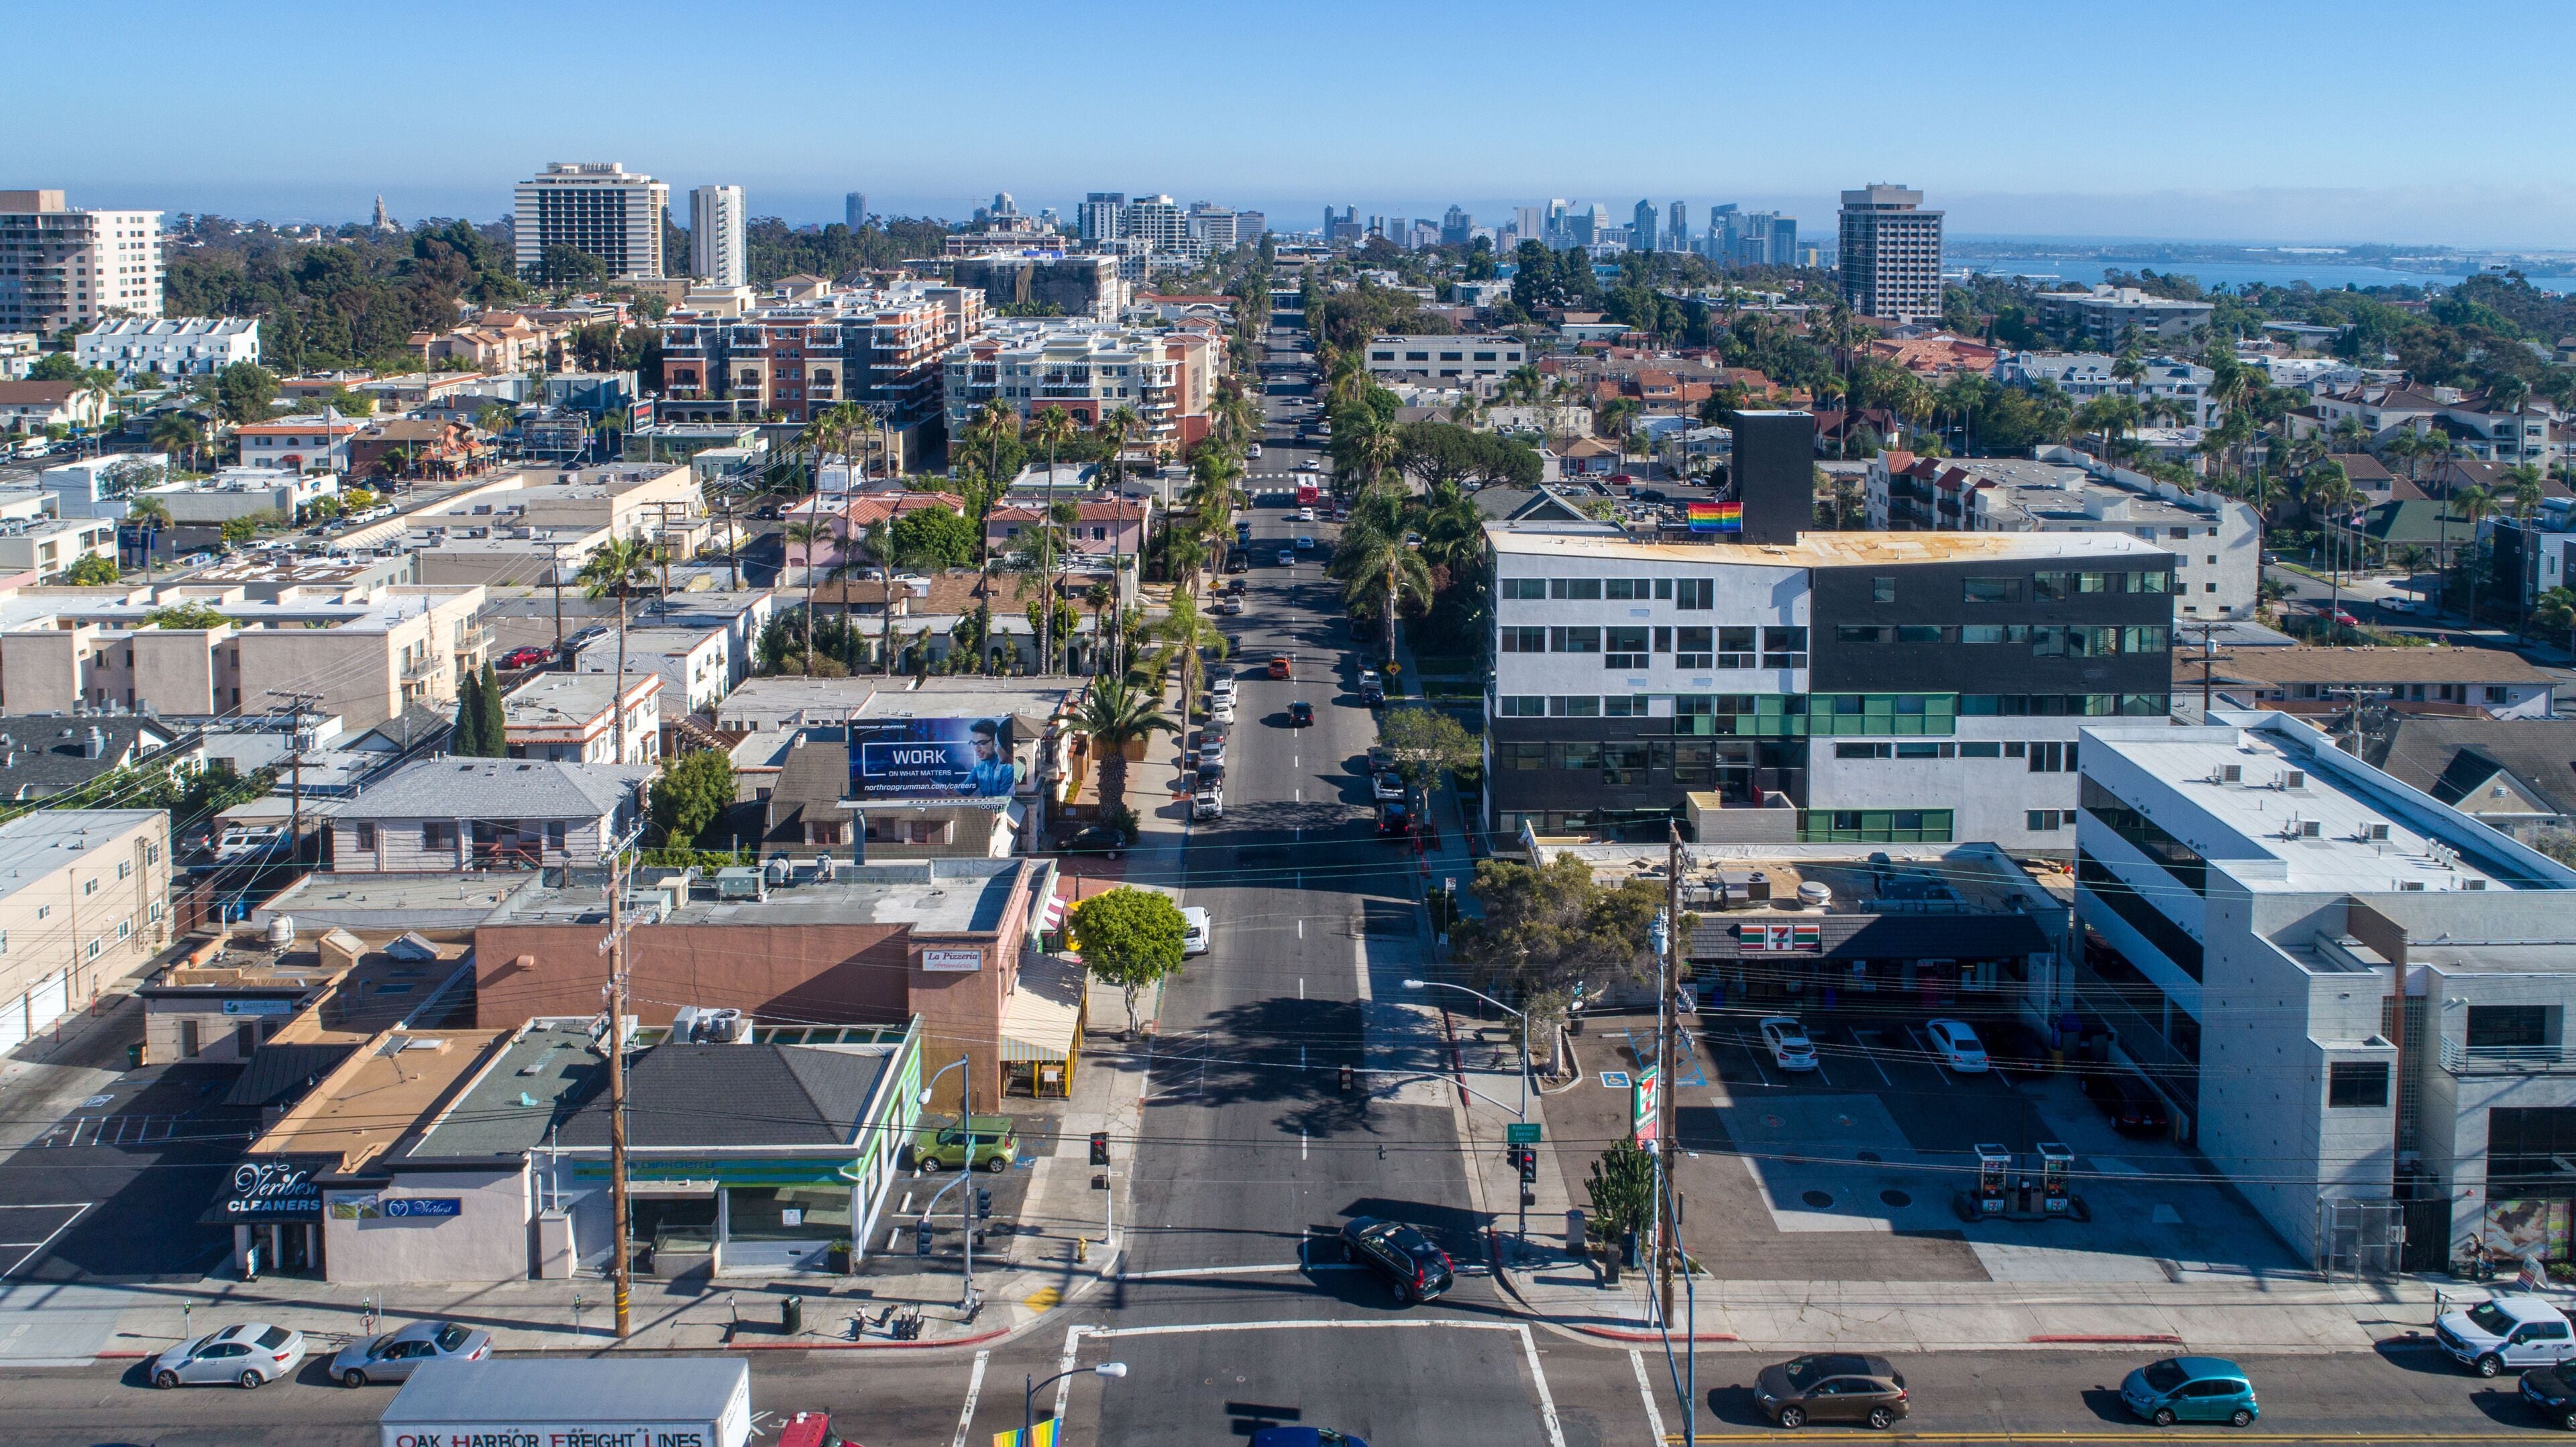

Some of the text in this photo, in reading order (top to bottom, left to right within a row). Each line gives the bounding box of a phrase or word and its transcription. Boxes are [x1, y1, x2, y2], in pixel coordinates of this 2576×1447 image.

[893, 749, 947, 765] WORK
[864, 782, 977, 792] northropgrumman.com/careers
[1772, 927, 1788, 949] 7
[943, 952, 977, 960] Pizzeria
[228, 1199, 321, 1212] CLEANERS
[415, 1201, 452, 1214] Veribest
[396, 1434, 702, 1447] OAK HARBOR FREIGHT LINES
